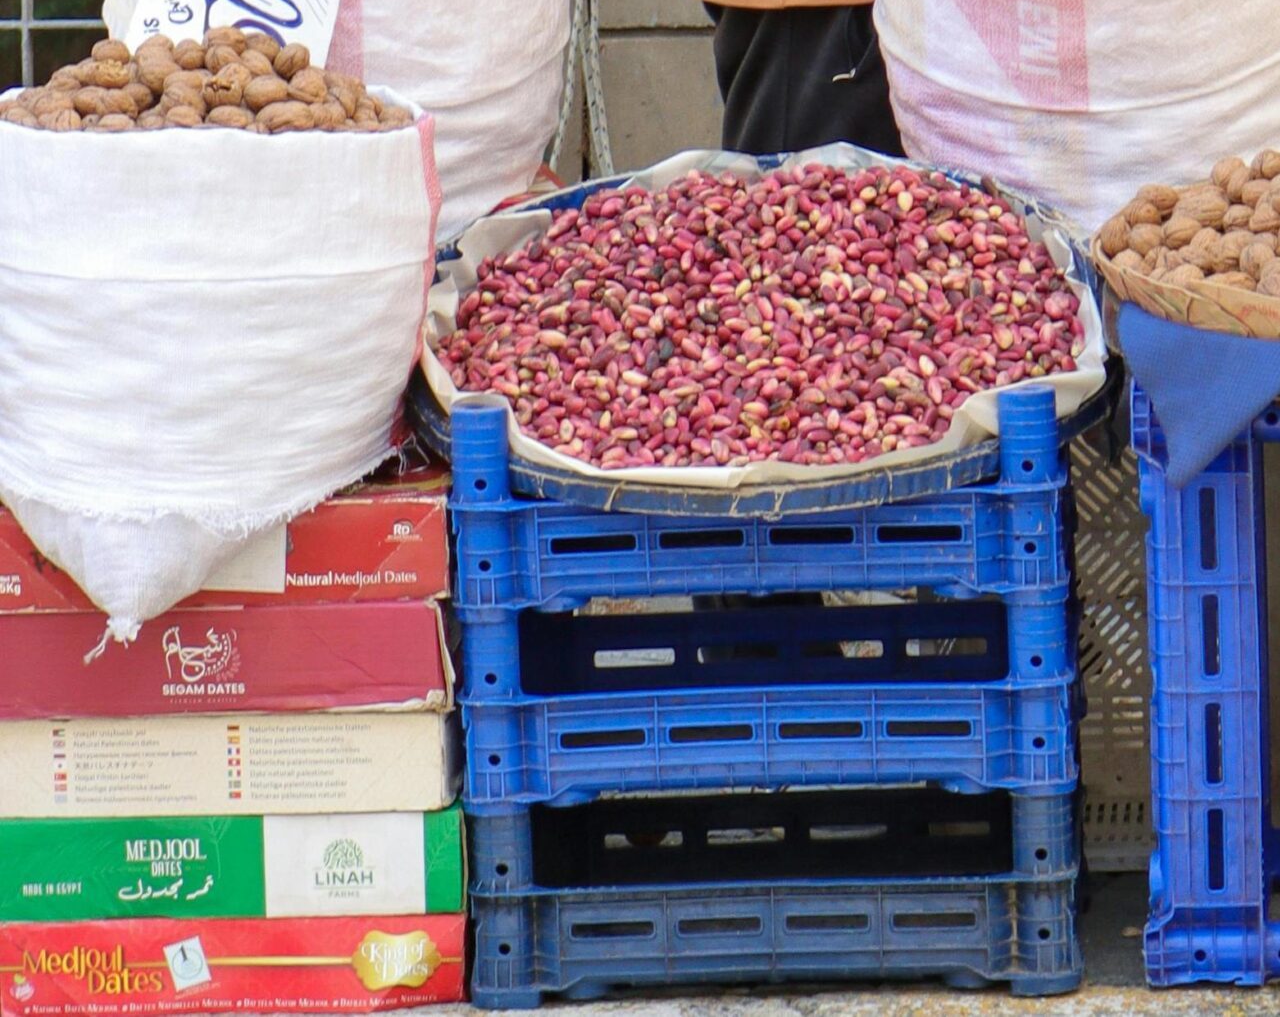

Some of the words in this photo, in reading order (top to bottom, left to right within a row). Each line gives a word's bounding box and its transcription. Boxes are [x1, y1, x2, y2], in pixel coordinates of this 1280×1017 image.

[286, 571, 332, 586] Natural
[334, 573, 380, 589] Medjoul
[385, 570, 417, 584] Dates
[207, 683, 245, 695] DATES
[125, 839, 206, 861] MEDJOOL
[151, 861, 182, 877] DATES
[315, 870, 373, 885] LINAH
[57, 882, 81, 895] EGYPT
[23, 944, 123, 979] Medjoul
[88, 968, 163, 995] Dates
